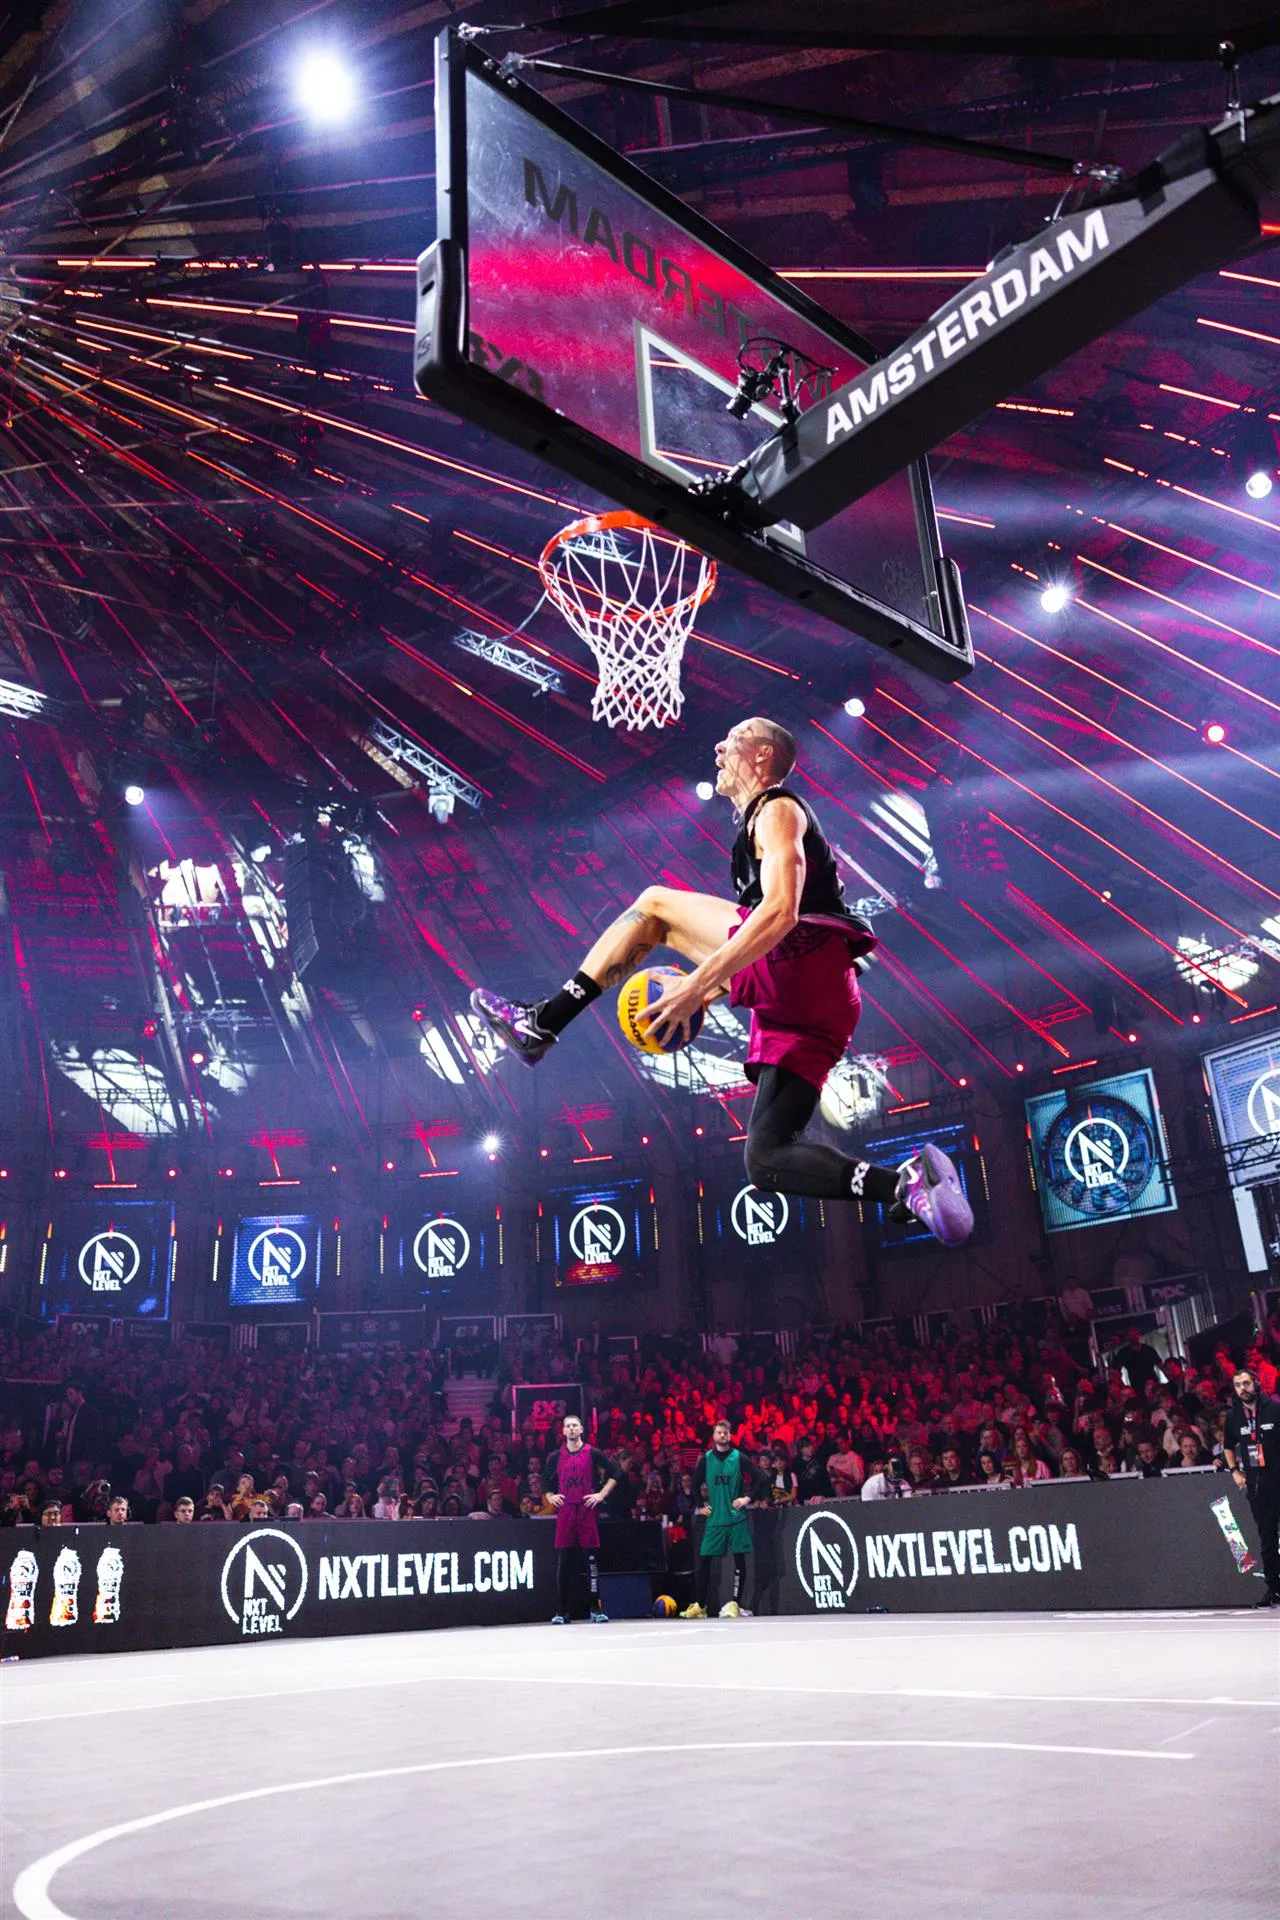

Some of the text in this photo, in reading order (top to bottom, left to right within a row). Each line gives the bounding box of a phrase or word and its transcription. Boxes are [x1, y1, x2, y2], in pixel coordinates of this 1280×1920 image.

[826, 208, 1110, 445] AMSTERDAM
[865, 1523, 1082, 1578] NXTLEVEL.COM
[318, 1549, 534, 1601] NXTLEVEL.COM
[813, 1574, 832, 1592] NXT
[243, 1597, 268, 1617] NXT
[814, 1591, 846, 1609] LEVEL
[242, 1614, 283, 1635] LEVEL
